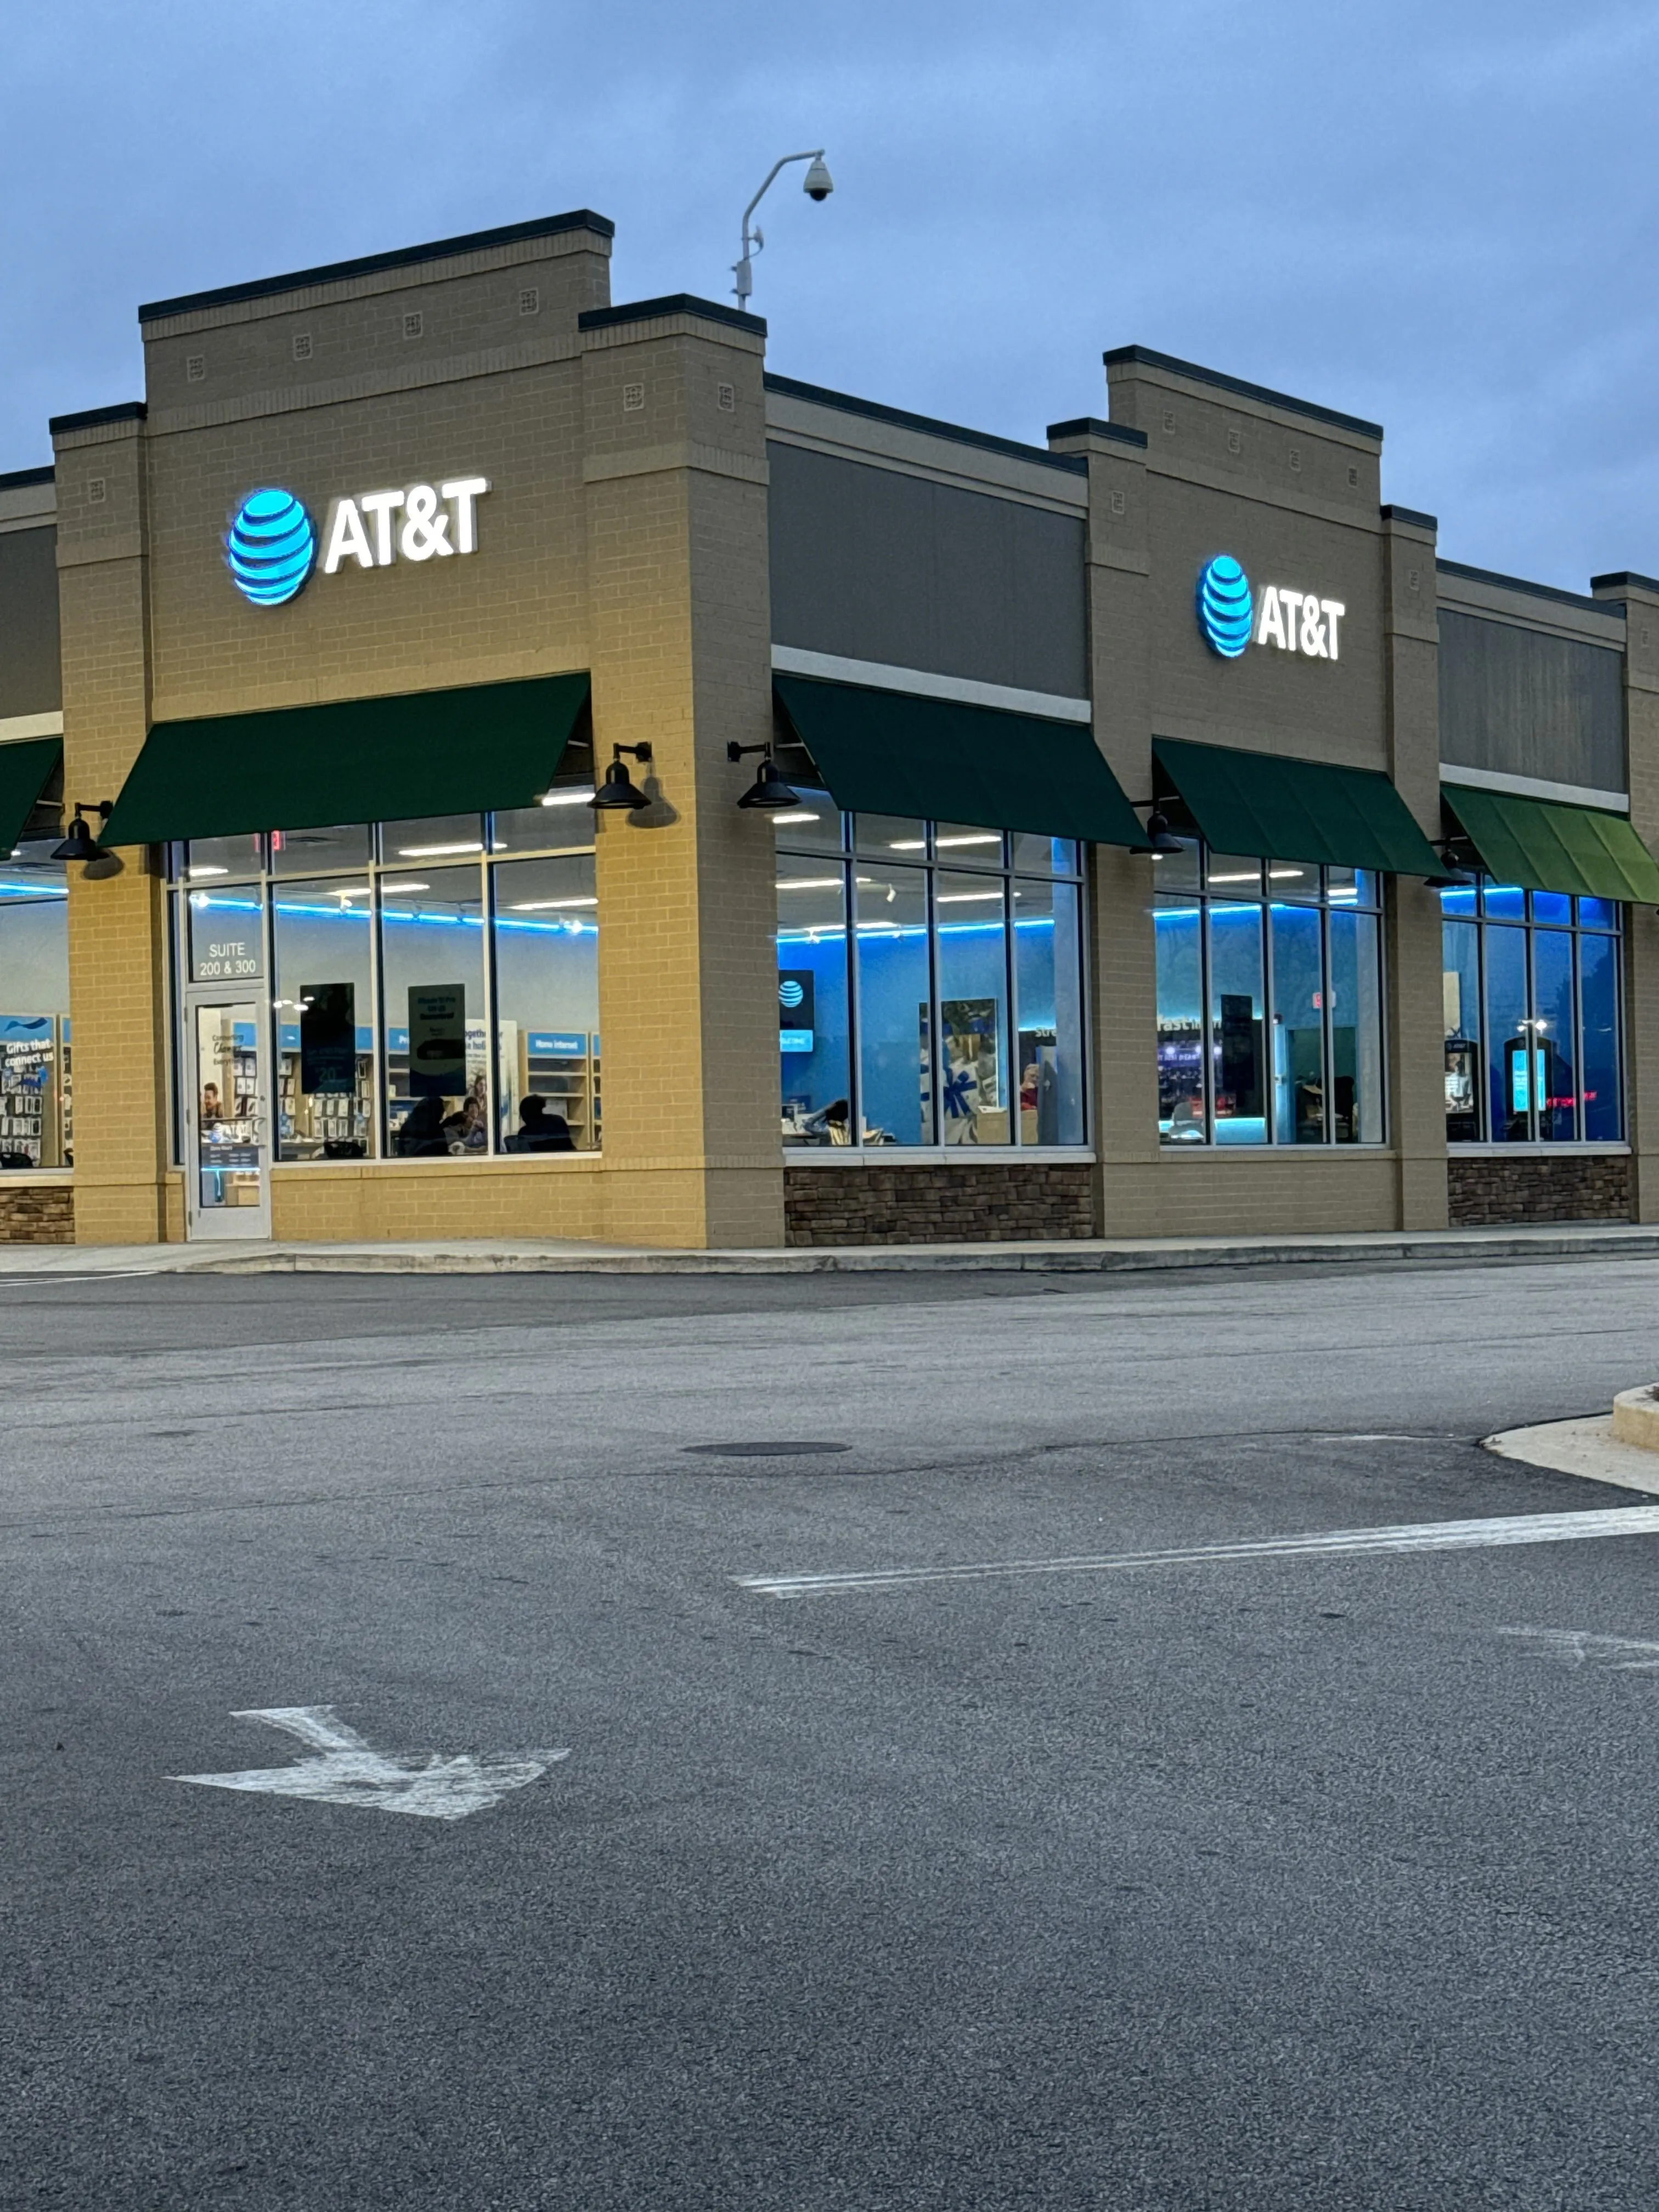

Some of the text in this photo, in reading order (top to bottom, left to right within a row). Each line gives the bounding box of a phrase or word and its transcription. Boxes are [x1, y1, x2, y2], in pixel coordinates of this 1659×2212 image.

[323, 477, 489, 574] AT&T
[1256, 585, 1345, 661] AT&T
[209, 942, 246, 958] SUITE
[200, 959, 256, 976] 200 & 300
[1035, 1026, 1057, 1037] Stre
[6, 1038, 51, 1054] Gifts that
[5, 1052, 54, 1068] connect us
